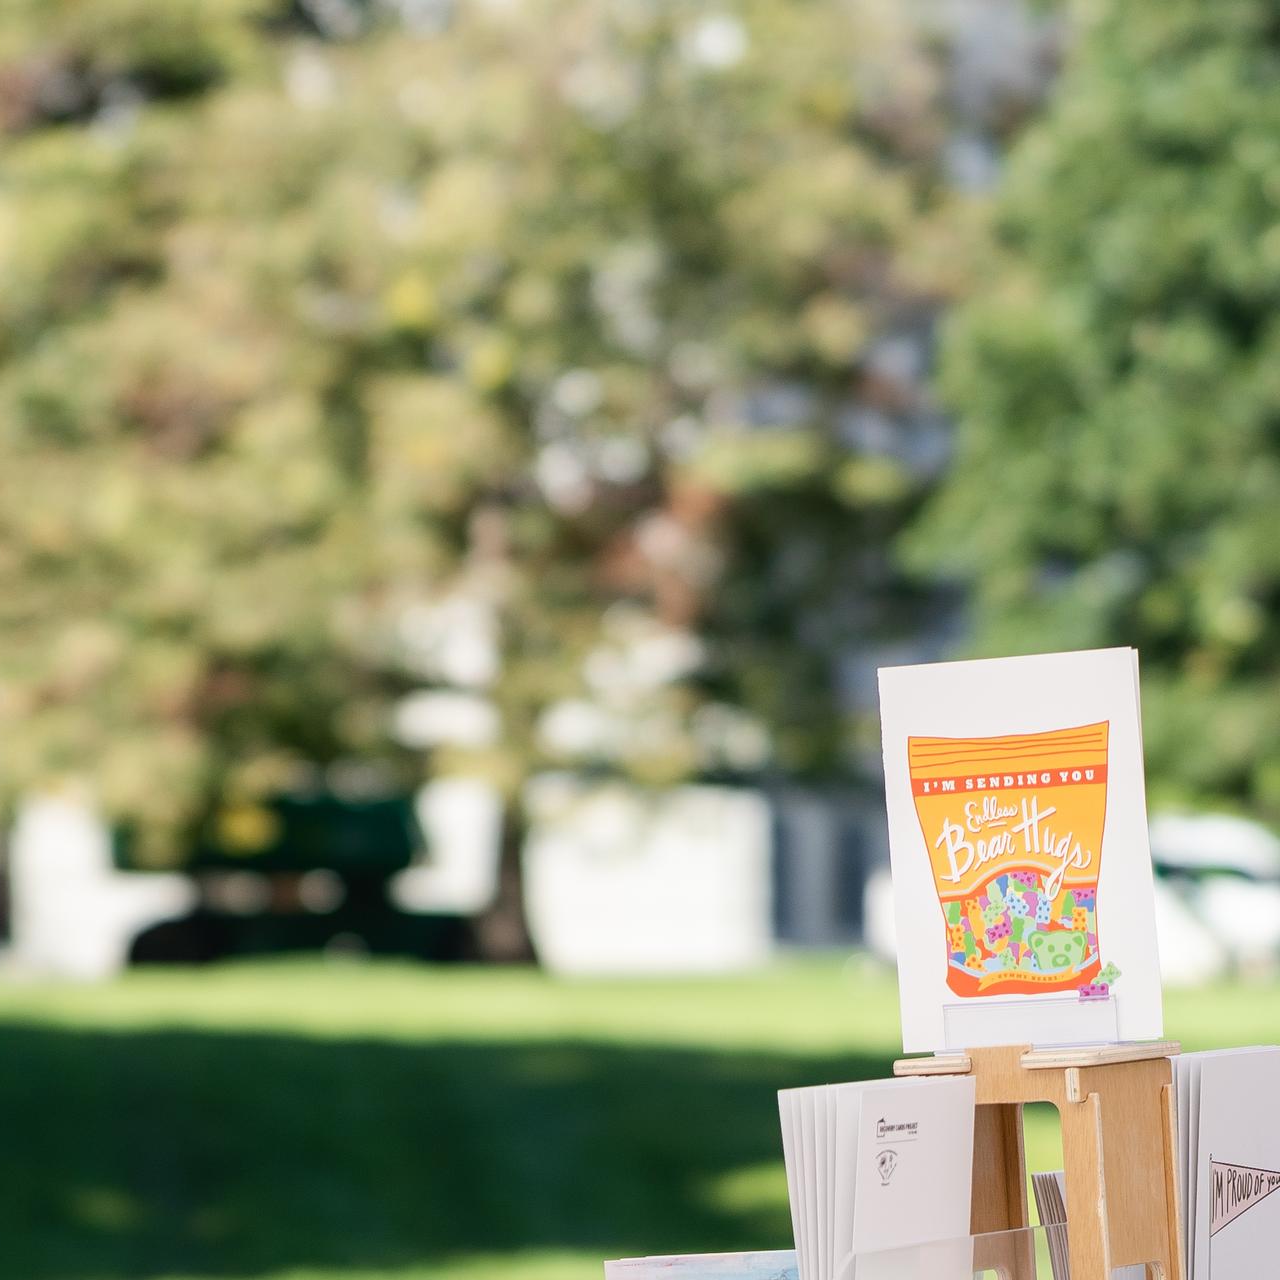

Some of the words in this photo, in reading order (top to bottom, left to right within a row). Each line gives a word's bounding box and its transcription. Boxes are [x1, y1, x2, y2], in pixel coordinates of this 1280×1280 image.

[923, 779, 955, 793] I'M
[965, 773, 1051, 789] SENDING
[1060, 769, 1095, 782] YOU
[964, 796, 1018, 833] Endless
[935, 818, 1016, 884] Bear
[1012, 796, 1092, 900] Hugs
[1227, 1168, 1252, 1214] PROUD
[1254, 1173, 1264, 1196] OF
